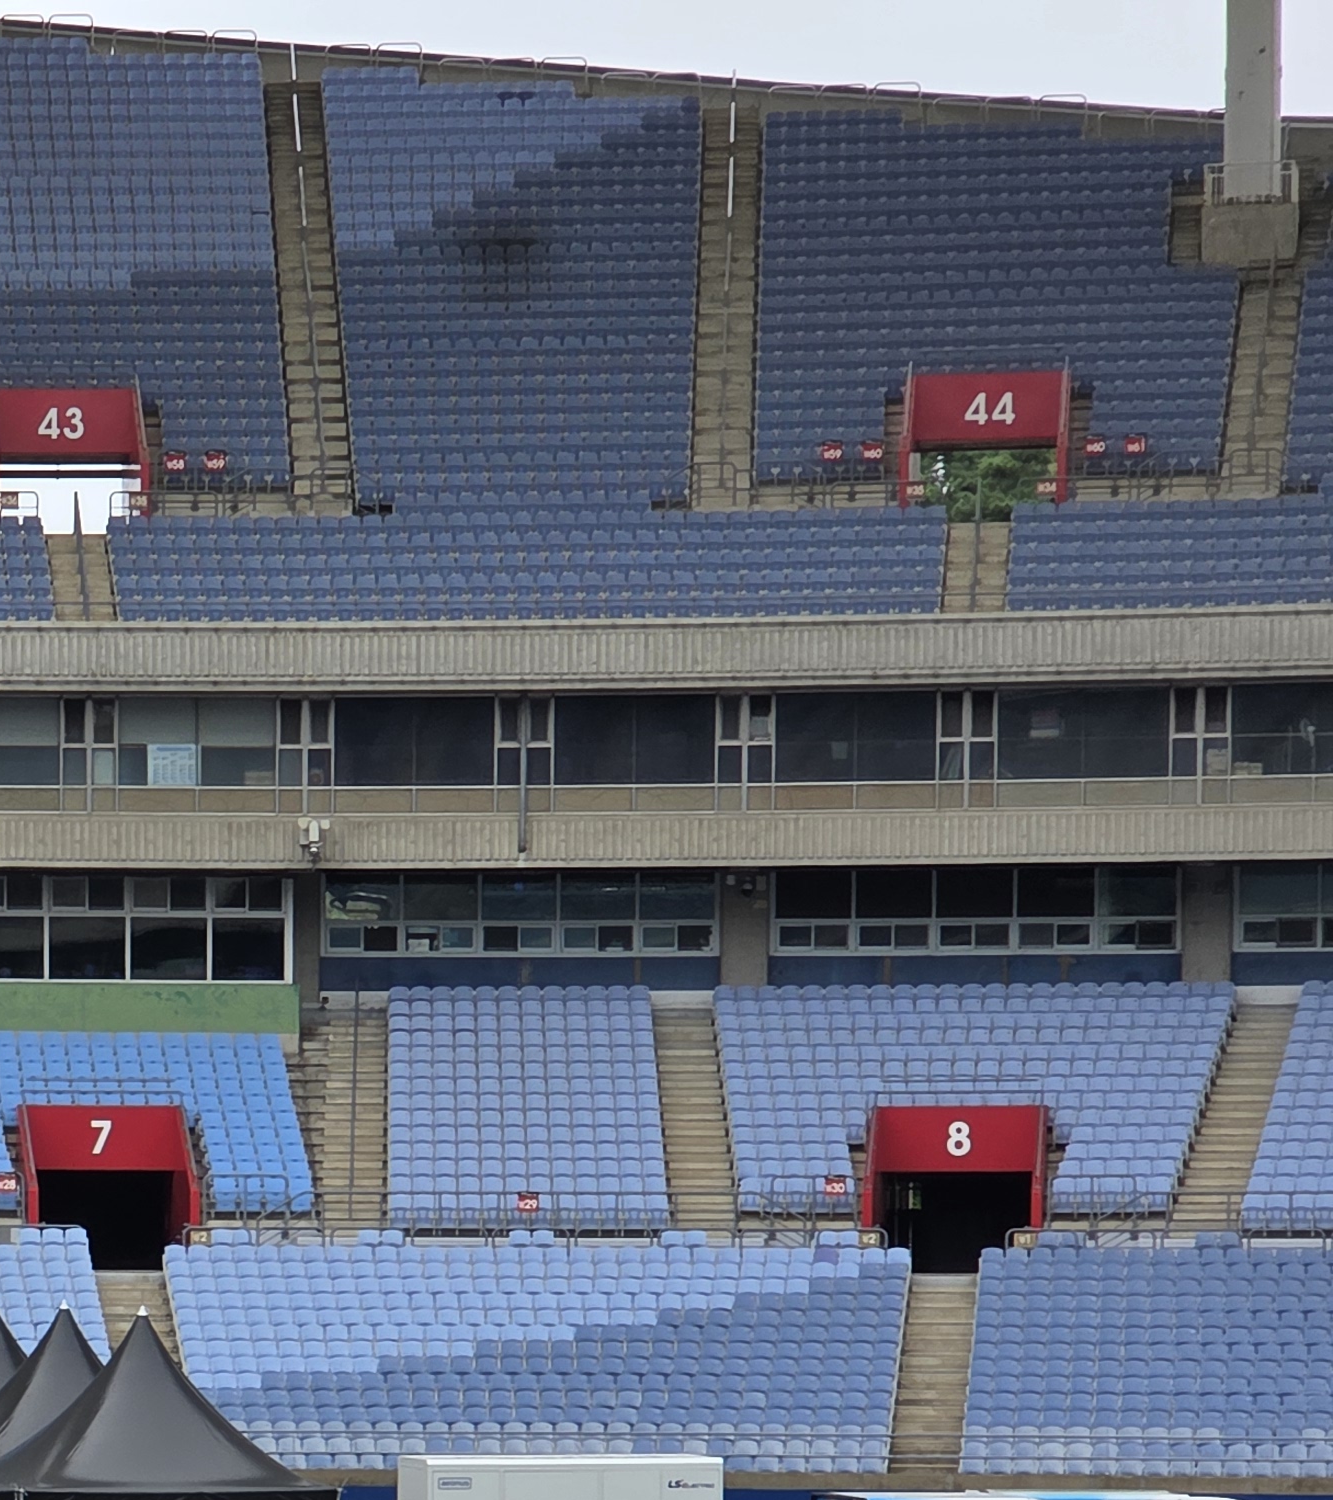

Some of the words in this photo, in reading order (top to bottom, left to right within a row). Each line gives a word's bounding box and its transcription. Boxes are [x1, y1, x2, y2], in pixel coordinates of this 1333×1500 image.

[38, 407, 85, 440] 43
[964, 391, 1017, 426] 44
[90, 1120, 112, 1155] 7
[946, 1121, 971, 1157] 8
